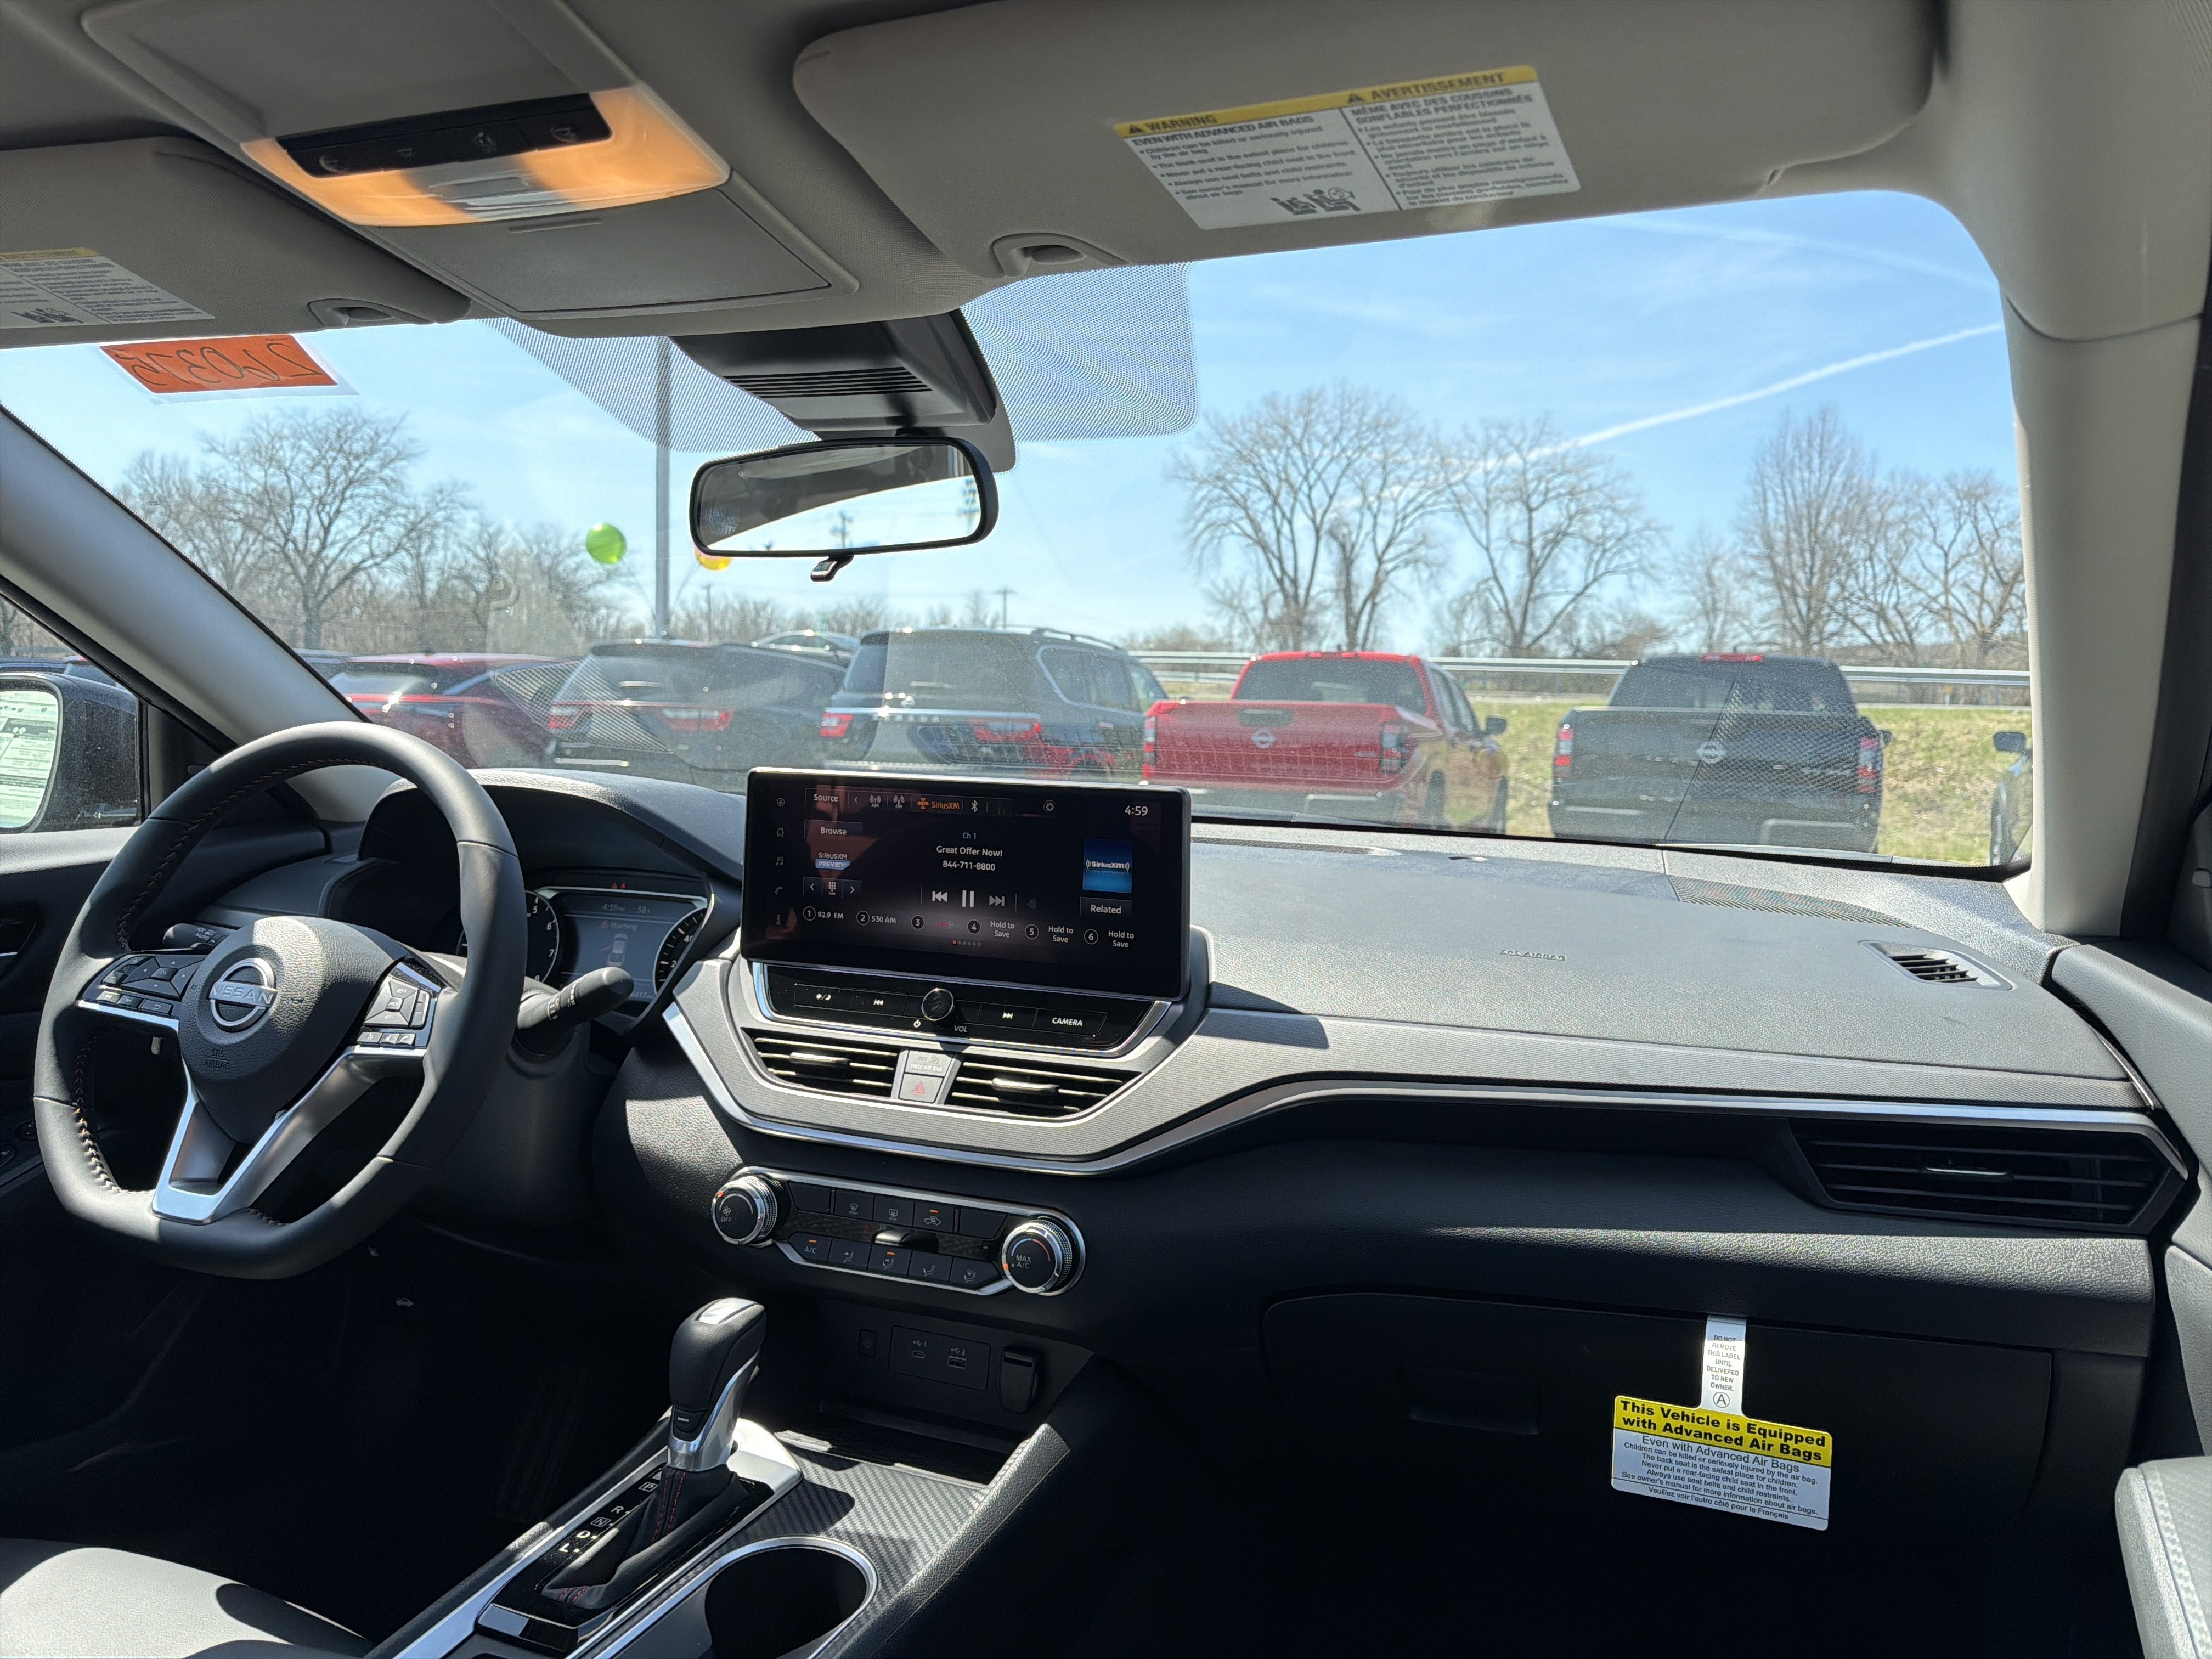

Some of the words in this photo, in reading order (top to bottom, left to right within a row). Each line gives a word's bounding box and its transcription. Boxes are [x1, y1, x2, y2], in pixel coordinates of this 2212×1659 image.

[1146, 115, 1217, 131] WARNING
[1132, 136, 1163, 146] EVEN
[1165, 132, 1193, 142] WITH
[1194, 125, 1256, 138] ADVANCED
[1257, 120, 1278, 129] AIR
[1279, 116, 1314, 126] BAGS
[814, 793, 839, 802] Source
[932, 801, 960, 810] SiriusXM
[1124, 805, 1148, 816] 4:59
[820, 826, 847, 836] Browse
[936, 845, 958, 854] Great
[960, 847, 980, 855] Offer
[982, 848, 1003, 857] Now!
[943, 860, 996, 871] 844-711-8800
[532, 906, 538, 914] 5
[1091, 904, 1121, 915] Related
[611, 922, 637, 932] Warning
[1053, 935, 1069, 943] Save
[1108, 930, 1125, 939] Hold
[1113, 940, 1129, 948] Save
[549, 949, 555, 957] 7
[211, 985, 274, 1004] NISSAN
[1052, 1017, 1083, 1027] CAMERA
[804, 1245, 817, 1254] A/C
[1016, 1255, 1031, 1263] MAX
[1712, 1342, 1736, 1351] REMOVE
[1722, 1352, 1740, 1360] LABEL
[1707, 1365, 1739, 1376] DELIVERED
[1717, 1394, 1726, 1405] A
[1621, 1400, 1655, 1416] This
[1660, 1407, 1720, 1427] Vehicle
[1726, 1419, 1740, 1431] is
[1747, 1423, 1825, 1447] Equipped
[1622, 1417, 1657, 1430] with
[1662, 1422, 1743, 1446] Advanced
[1749, 1438, 1774, 1452] Air
[1780, 1443, 1822, 1461] Bags
[1624, 1442, 1652, 1453] Children
[1679, 1452, 1697, 1461] killed
[1707, 1458, 1739, 1470] seriously
[1741, 1464, 1765, 1474] injured
[1642, 1435, 1668, 1448] Even
[1672, 1442, 1693, 1453] with
[1696, 1446, 1749, 1463] Advanced
[1752, 1455, 1768, 1466] Air
[1771, 1459, 1799, 1473] Bags
[1642, 1452, 1655, 1460] The
[1657, 1455, 1673, 1464] back
[1674, 1459, 1690, 1468] seat
[1712, 1467, 1734, 1476] safest
[1735, 1471, 1754, 1480] place
[1641, 1460, 1662, 1470] Never
[1683, 1469, 1720, 1482] rear-facing
[1722, 1476, 1739, 1485] child
[1779, 1486, 1798, 1496] front.
[1647, 1469, 1671, 1479] Always
[1704, 1479, 1720, 1488] belts
[1737, 1487, 1754, 1495] child
[1622, 1471, 1635, 1480] See
[1637, 1475, 1664, 1485] owner's
[1665, 1481, 1690, 1490] manual
[1703, 1488, 1722, 1496] more
[1723, 1491, 1763, 1504] information
[1764, 1499, 1785, 1509] about
[1798, 1505, 1818, 1515] bags.
[1648, 1486, 1675, 1497] Veuillez
[1691, 1494, 1712, 1504] l'autre
[1731, 1503, 1748, 1511] pour
[1758, 1508, 1788, 1519] Français
[576, 1530, 591, 1538] D
[558, 1543, 570, 1553] L
